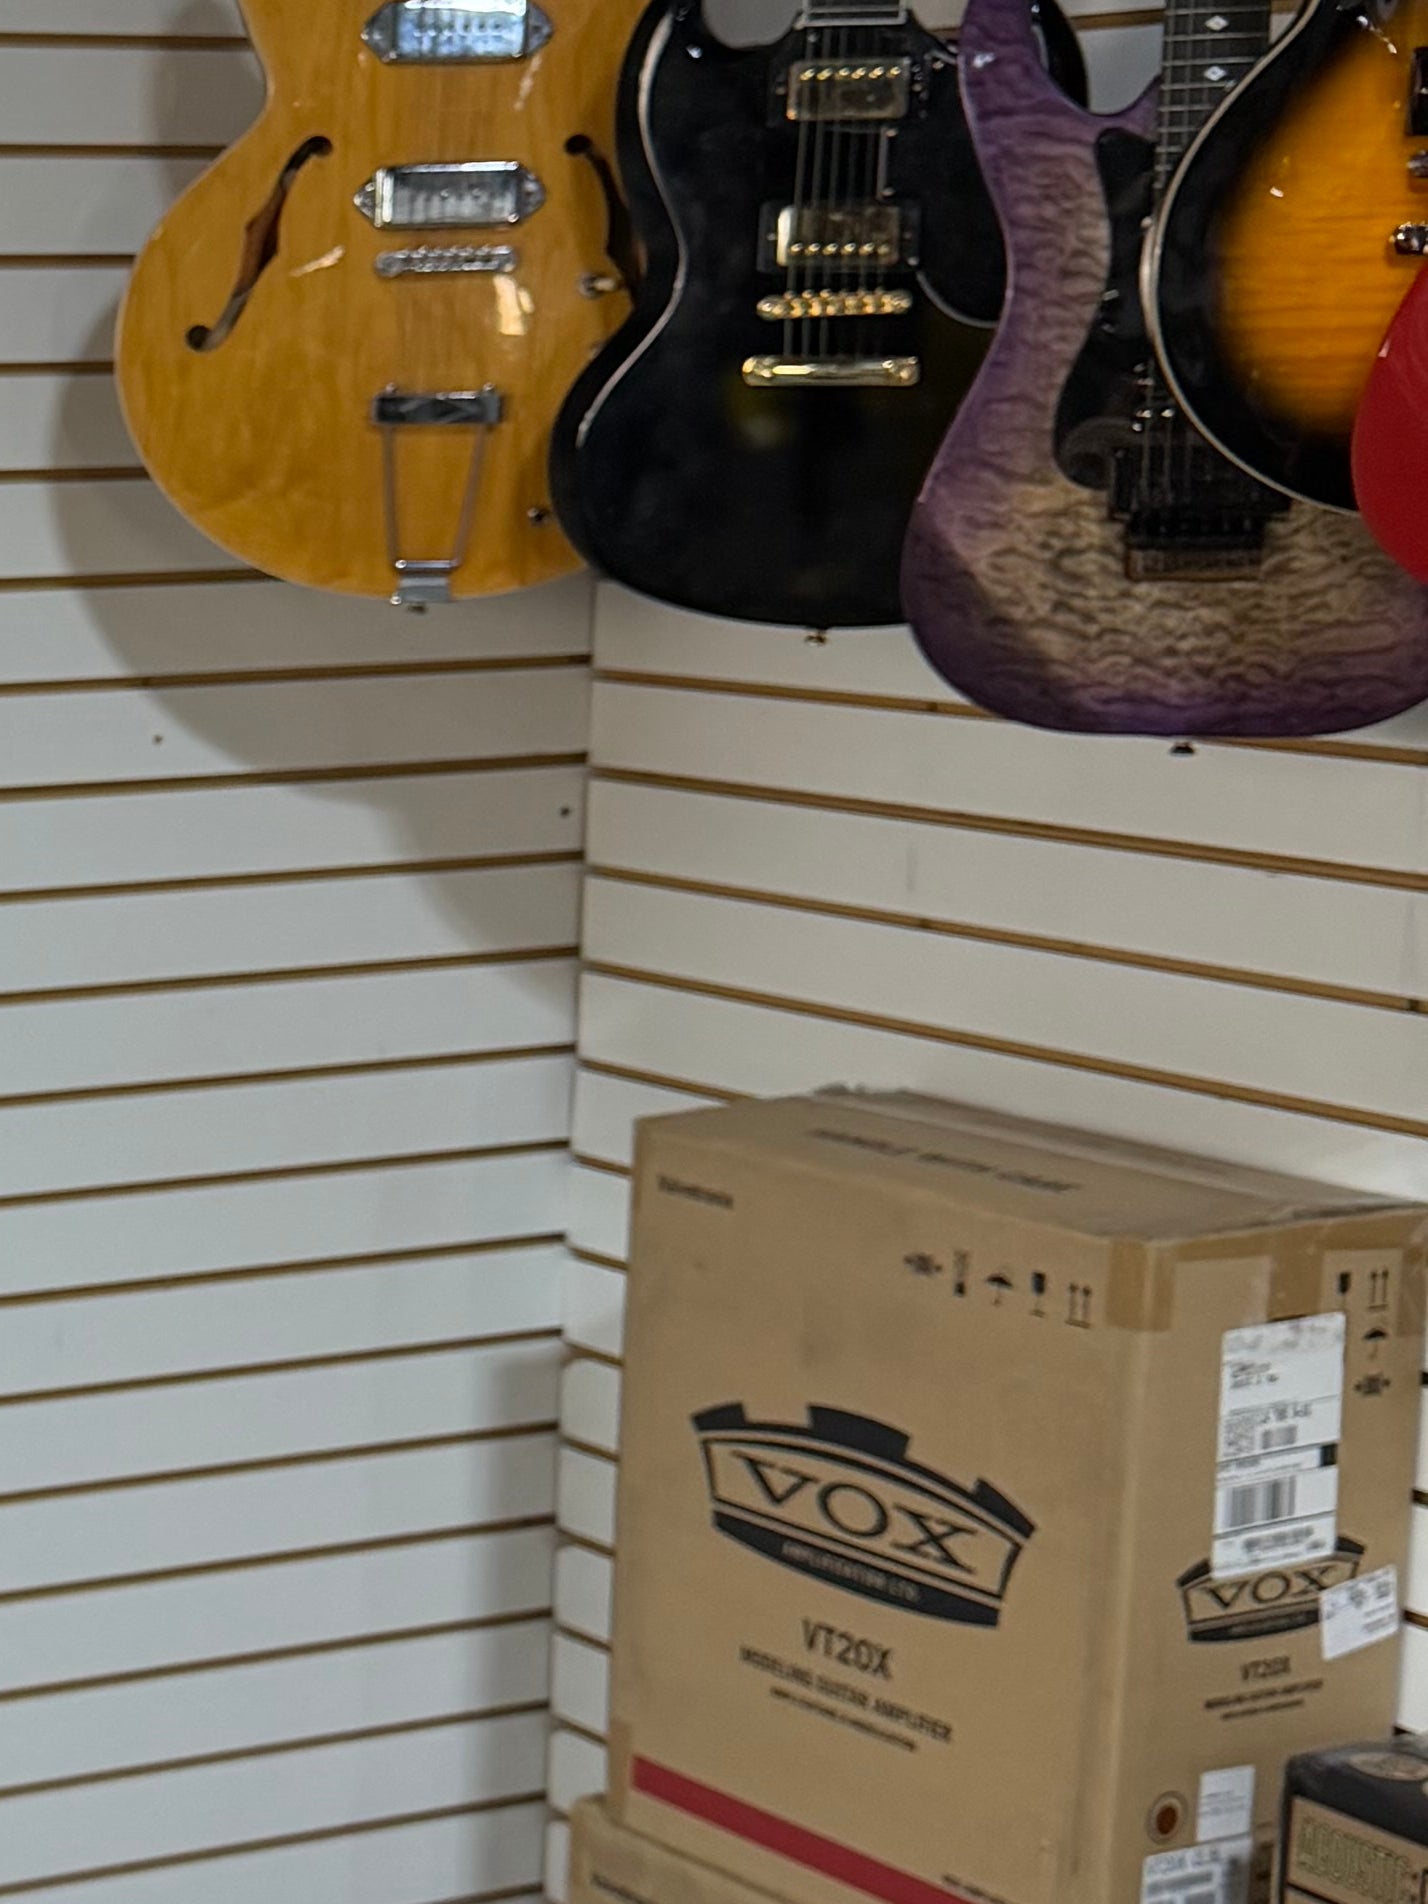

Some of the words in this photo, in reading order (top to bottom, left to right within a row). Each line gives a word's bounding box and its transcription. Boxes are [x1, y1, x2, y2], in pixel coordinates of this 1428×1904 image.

[730, 1448, 979, 1576] VOX
[1200, 1563, 1337, 1610] VOX
[801, 1616, 894, 1679] VT20X
